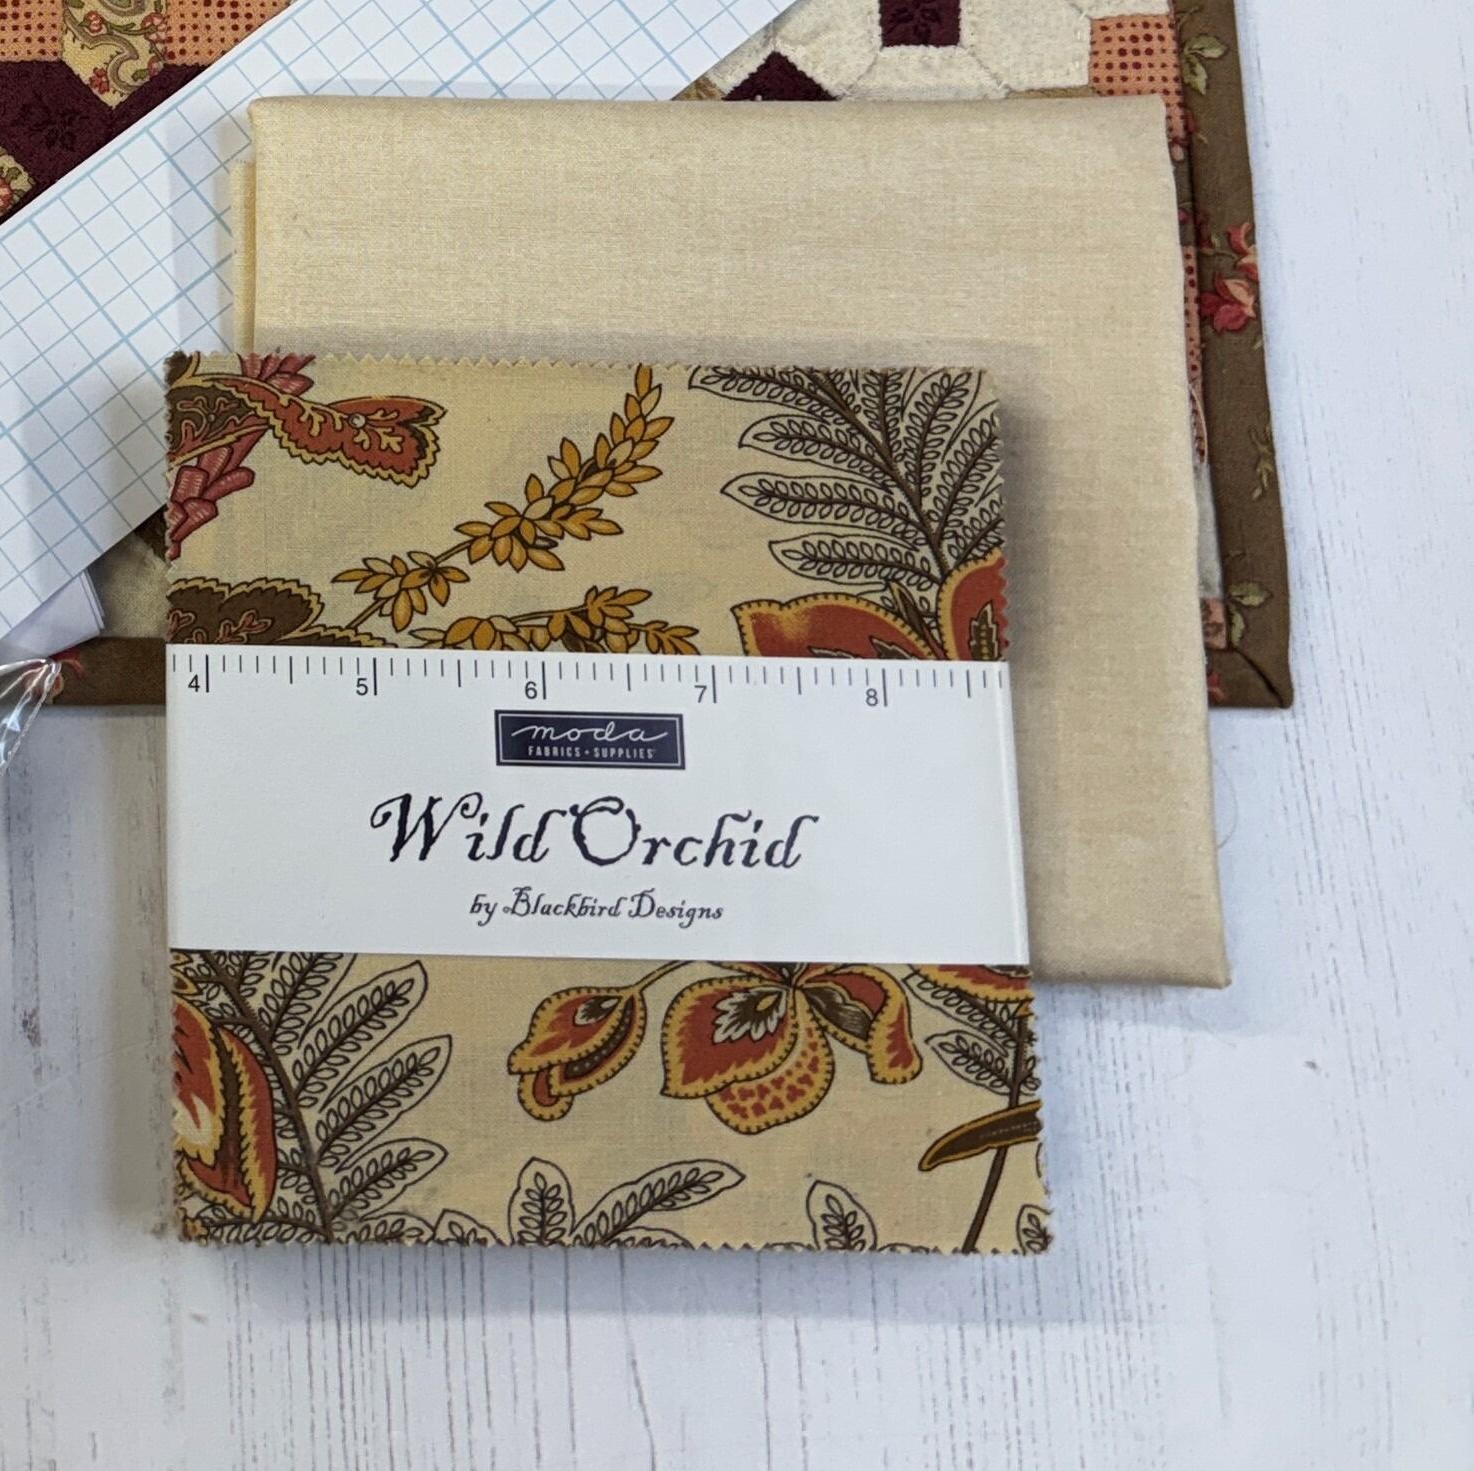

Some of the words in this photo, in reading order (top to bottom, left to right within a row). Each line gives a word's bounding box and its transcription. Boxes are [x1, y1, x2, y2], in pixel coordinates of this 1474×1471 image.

[186, 673, 202, 694] 4
[354, 676, 370, 697] 5
[523, 680, 539, 701] 6
[692, 684, 709, 705] 7
[864, 687, 880, 707] 8
[510, 719, 669, 743] moda
[527, 744, 582, 759] FABRICS
[591, 746, 655, 761] SUPPLIES
[369, 791, 569, 864] Wild
[568, 794, 821, 870] Orchid
[468, 892, 499, 928] by
[501, 884, 629, 920] Blackbird
[626, 886, 725, 930] Designs
